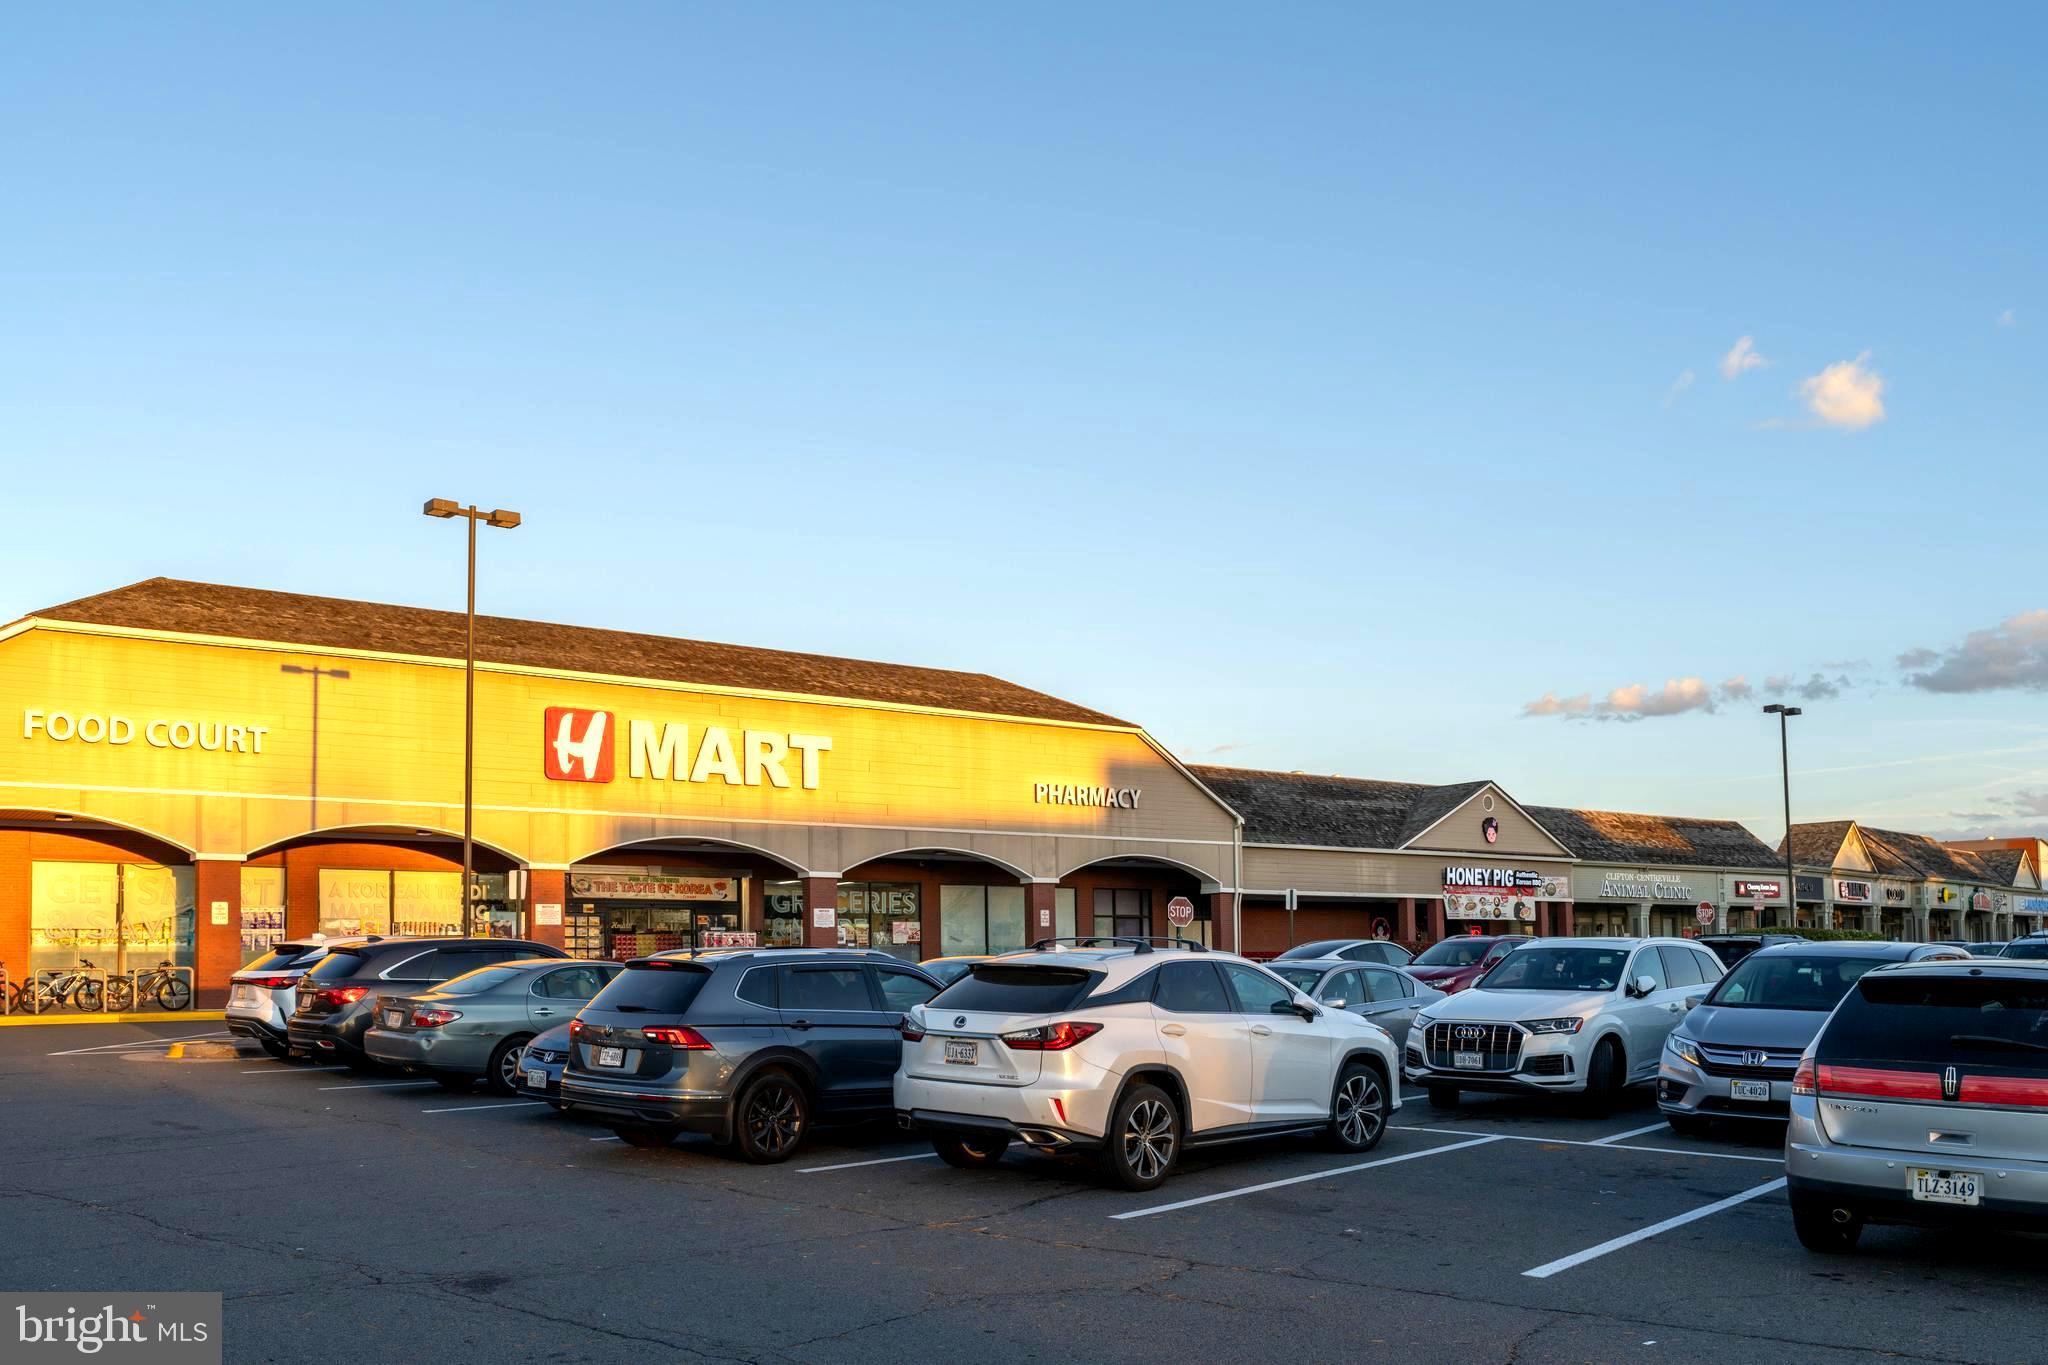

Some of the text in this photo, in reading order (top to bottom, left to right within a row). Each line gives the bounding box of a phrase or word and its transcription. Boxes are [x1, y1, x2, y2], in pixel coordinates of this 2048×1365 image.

[23, 709, 269, 754] FOOD COURT
[552, 711, 833, 790] H MART
[1034, 783, 1142, 809] PHARMACY
[1446, 867, 1514, 887] HONEY PIG
[593, 881, 713, 895] THE TASTE OF KOREA
[1601, 880, 1692, 899] ANIMAL CLINIC
[771, 889, 916, 915] GRCERIES
[1170, 905, 1192, 918] STOP
[1698, 908, 1713, 918] STOP
[1917, 1177, 1975, 1197] TLZ-3149
